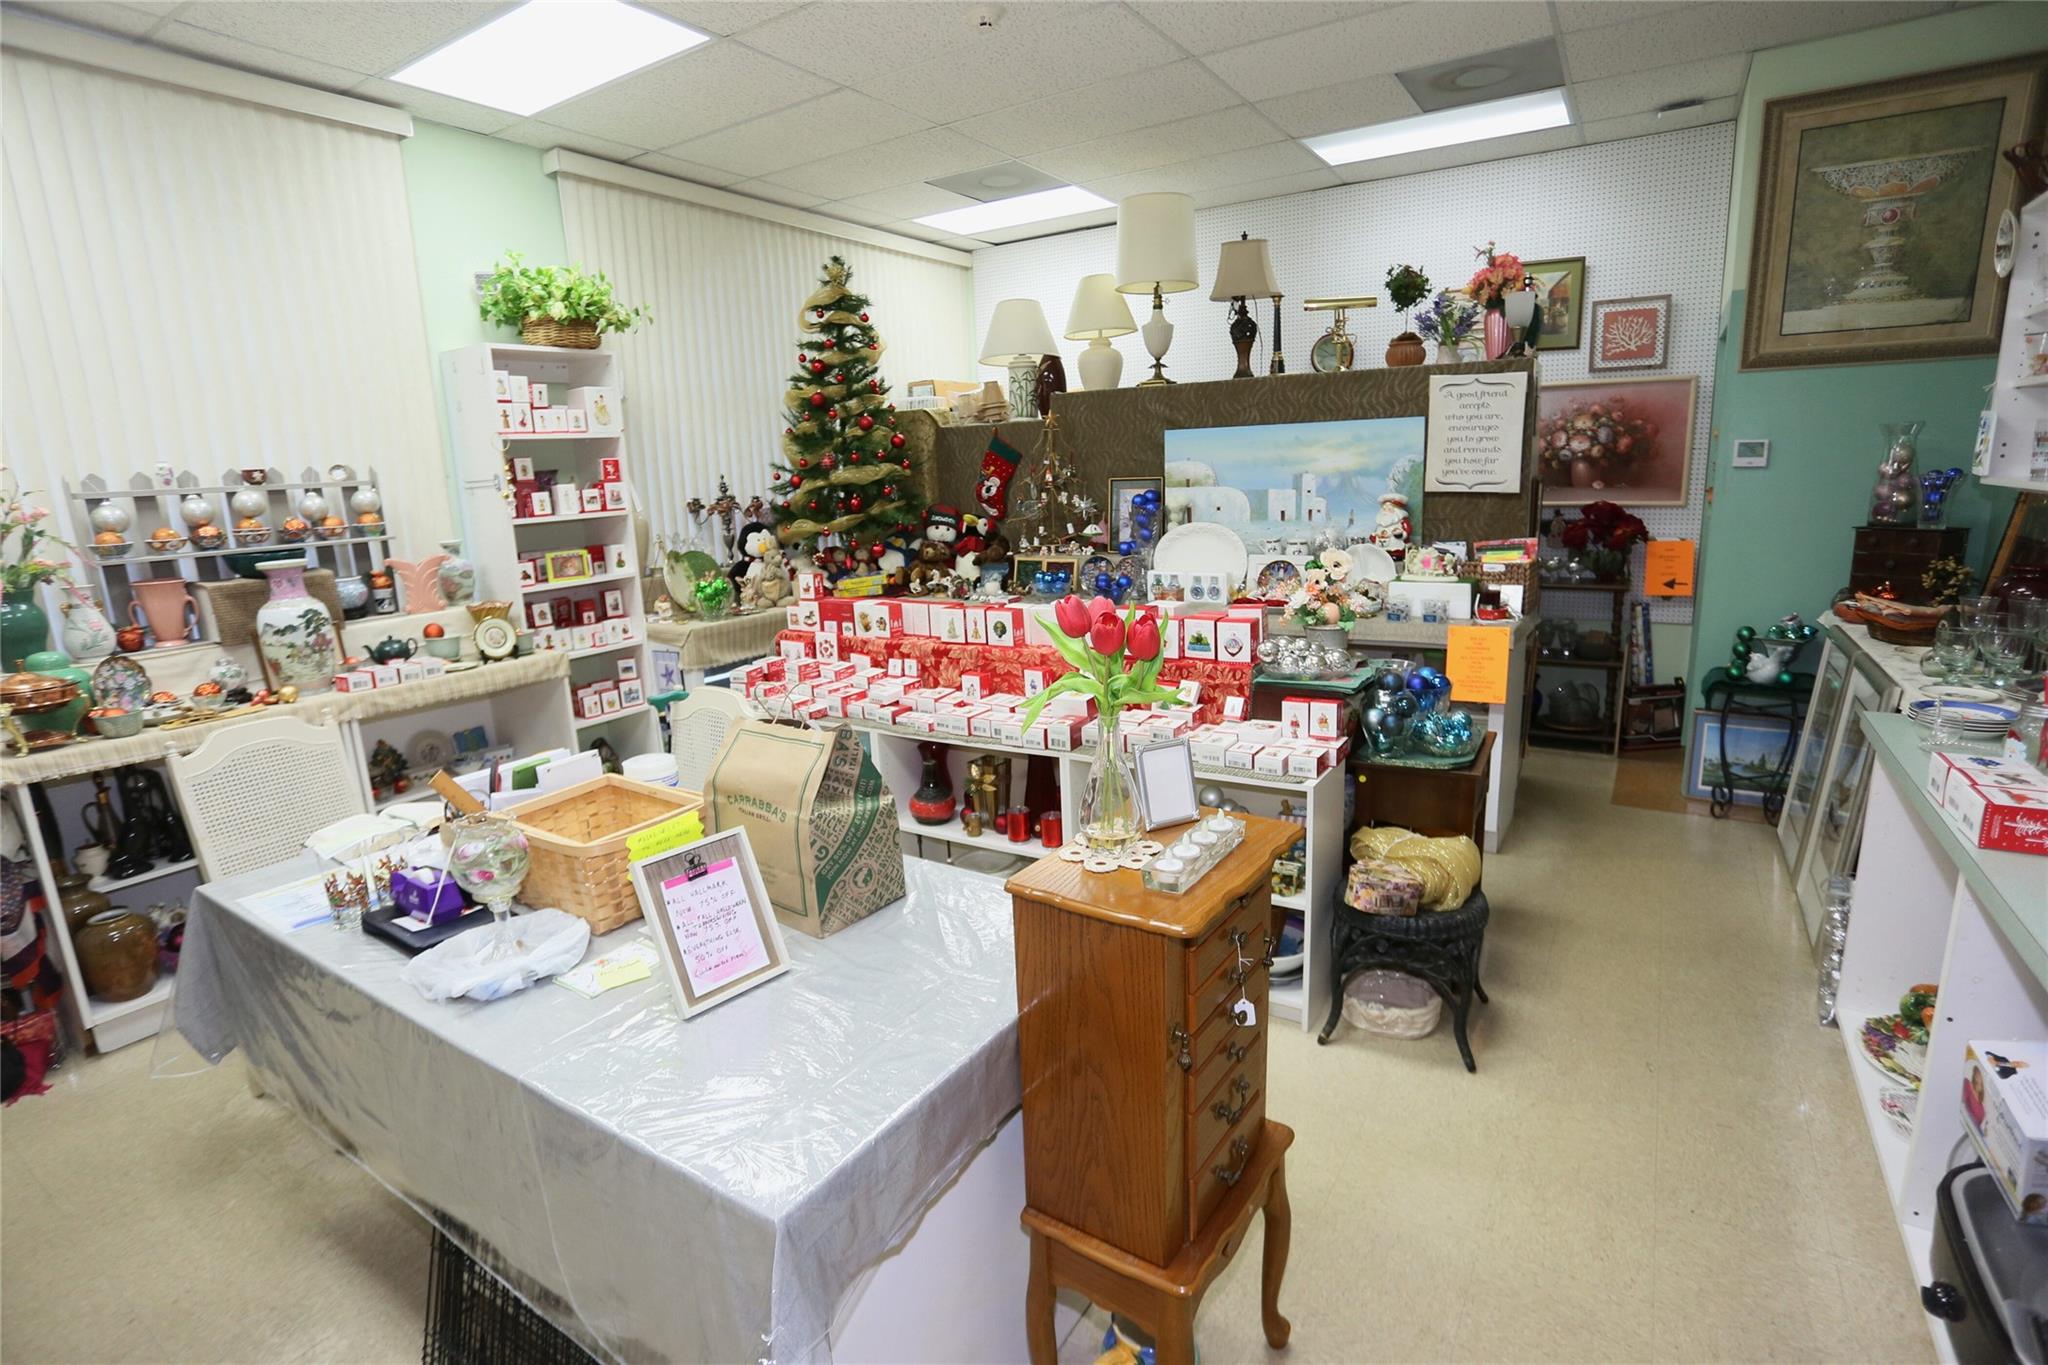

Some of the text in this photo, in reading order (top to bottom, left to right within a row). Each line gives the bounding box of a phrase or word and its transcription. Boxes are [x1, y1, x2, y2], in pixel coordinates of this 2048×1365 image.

[1443, 390, 1508, 401] A good friend
[1459, 402, 1491, 411] accepts
[1445, 413, 1464, 421] who
[1466, 414, 1483, 423] you
[1448, 425, 1500, 433] encourages
[1446, 436, 1463, 445] you
[1475, 436, 1500, 445] grow
[1445, 458, 1461, 466] you
[1481, 457, 1500, 467] far
[1442, 469, 1471, 477] you've
[727, 794, 787, 822] CARRABBA'S
[672, 895, 686, 904] ALL
